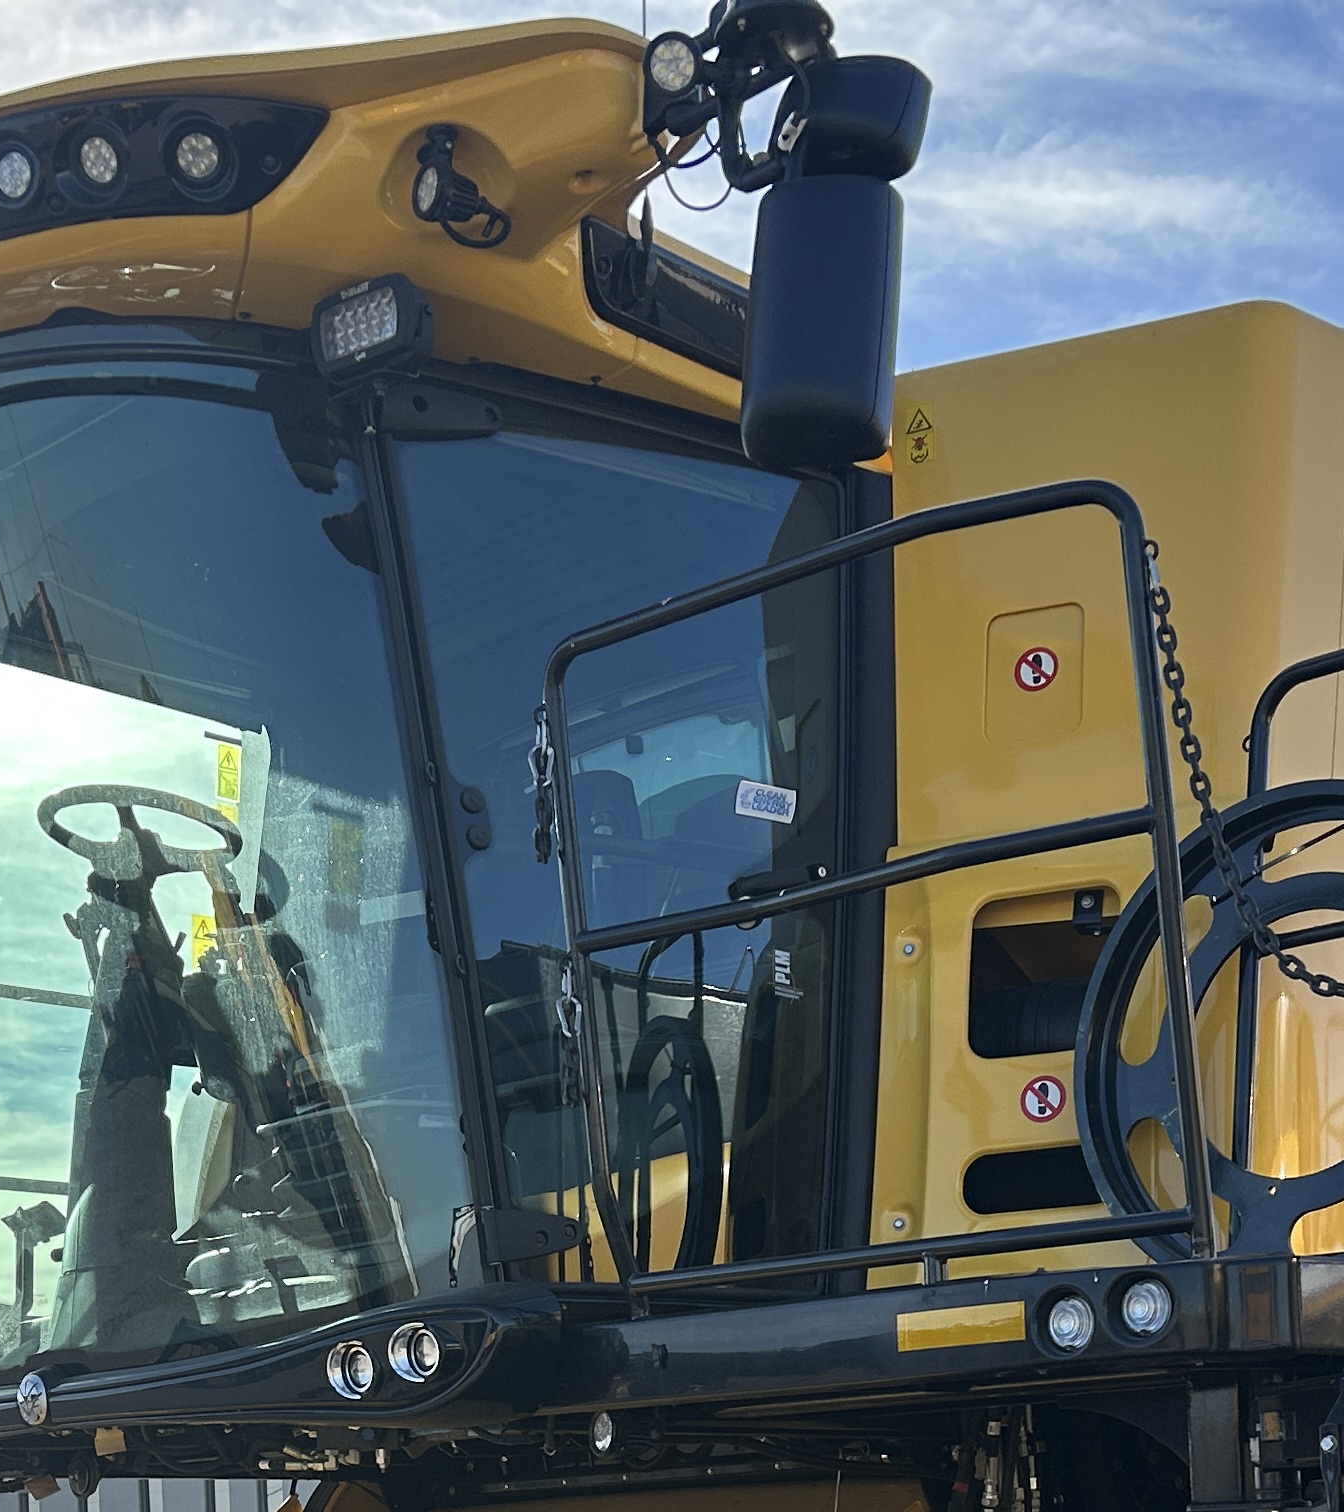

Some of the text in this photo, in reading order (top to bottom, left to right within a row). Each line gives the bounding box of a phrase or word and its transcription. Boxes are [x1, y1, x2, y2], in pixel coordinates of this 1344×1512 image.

[756, 788, 787, 801] CLEAN
[751, 802, 790, 817] LEADER
[774, 949, 791, 985] PLM
